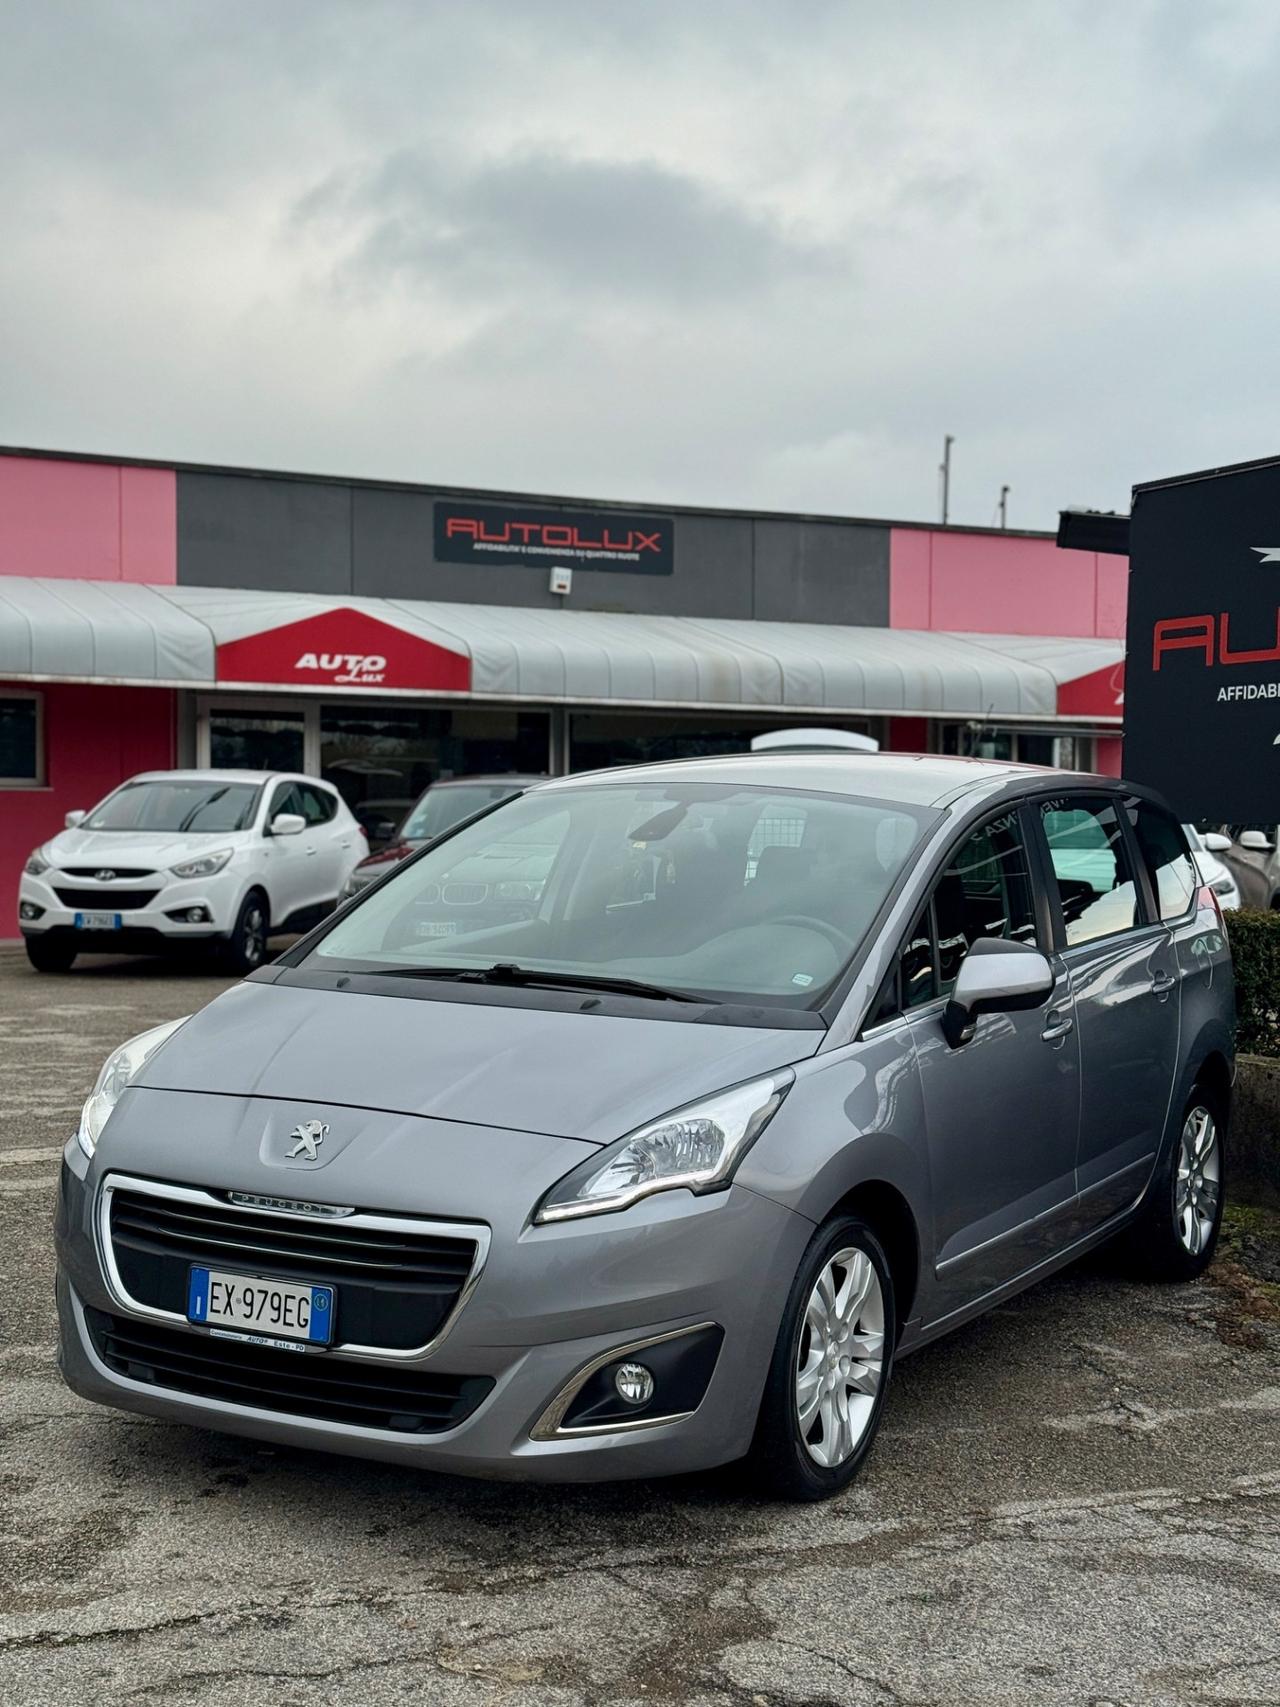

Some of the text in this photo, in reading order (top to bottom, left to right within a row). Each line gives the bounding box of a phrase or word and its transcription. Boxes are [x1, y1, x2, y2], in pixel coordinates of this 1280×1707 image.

[446, 518, 661, 552] AUTOLUX
[294, 653, 387, 672] AUTO
[210, 1281, 236, 1316] EX
[242, 1287, 310, 1328] 979EG
